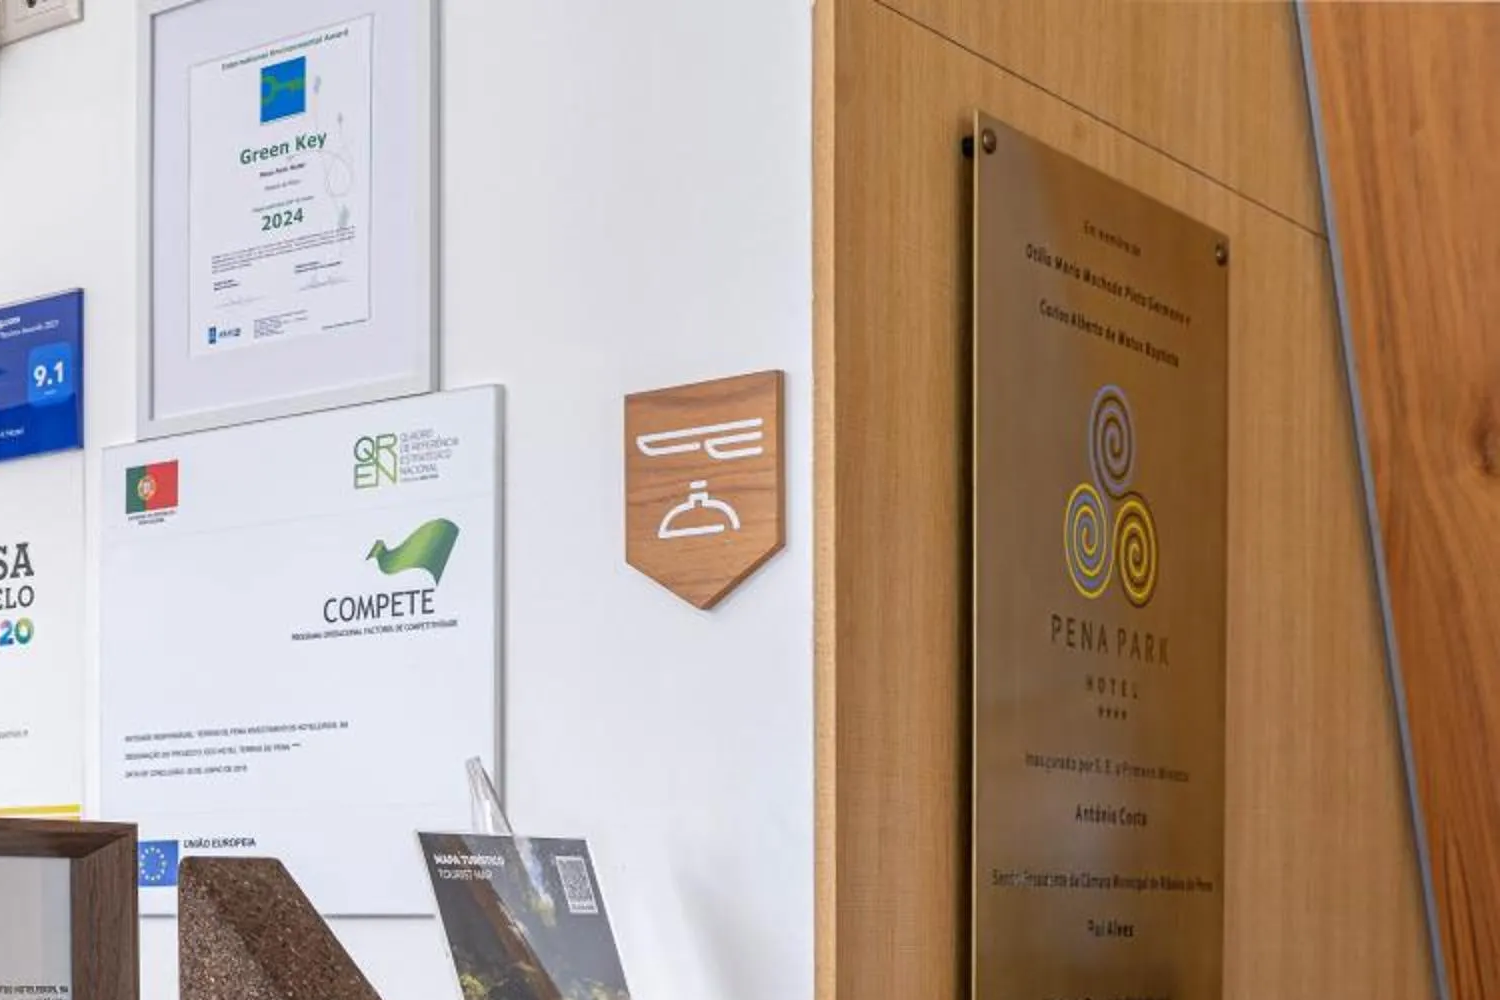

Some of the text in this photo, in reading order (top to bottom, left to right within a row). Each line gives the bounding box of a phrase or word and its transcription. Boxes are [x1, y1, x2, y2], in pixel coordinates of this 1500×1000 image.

[239, 132, 327, 165] Green Key
[261, 208, 304, 231] 2024
[33, 360, 65, 388] 9.1
[323, 588, 435, 623] COMPETE
[1051, 613, 1170, 666] PENA PARK
[1086, 674, 1138, 699] HOTEL
[1075, 803, 1148, 828] António Costa
[183, 836, 256, 849] UNIÃO EUROPEIA
[433, 853, 461, 866] MAPA
